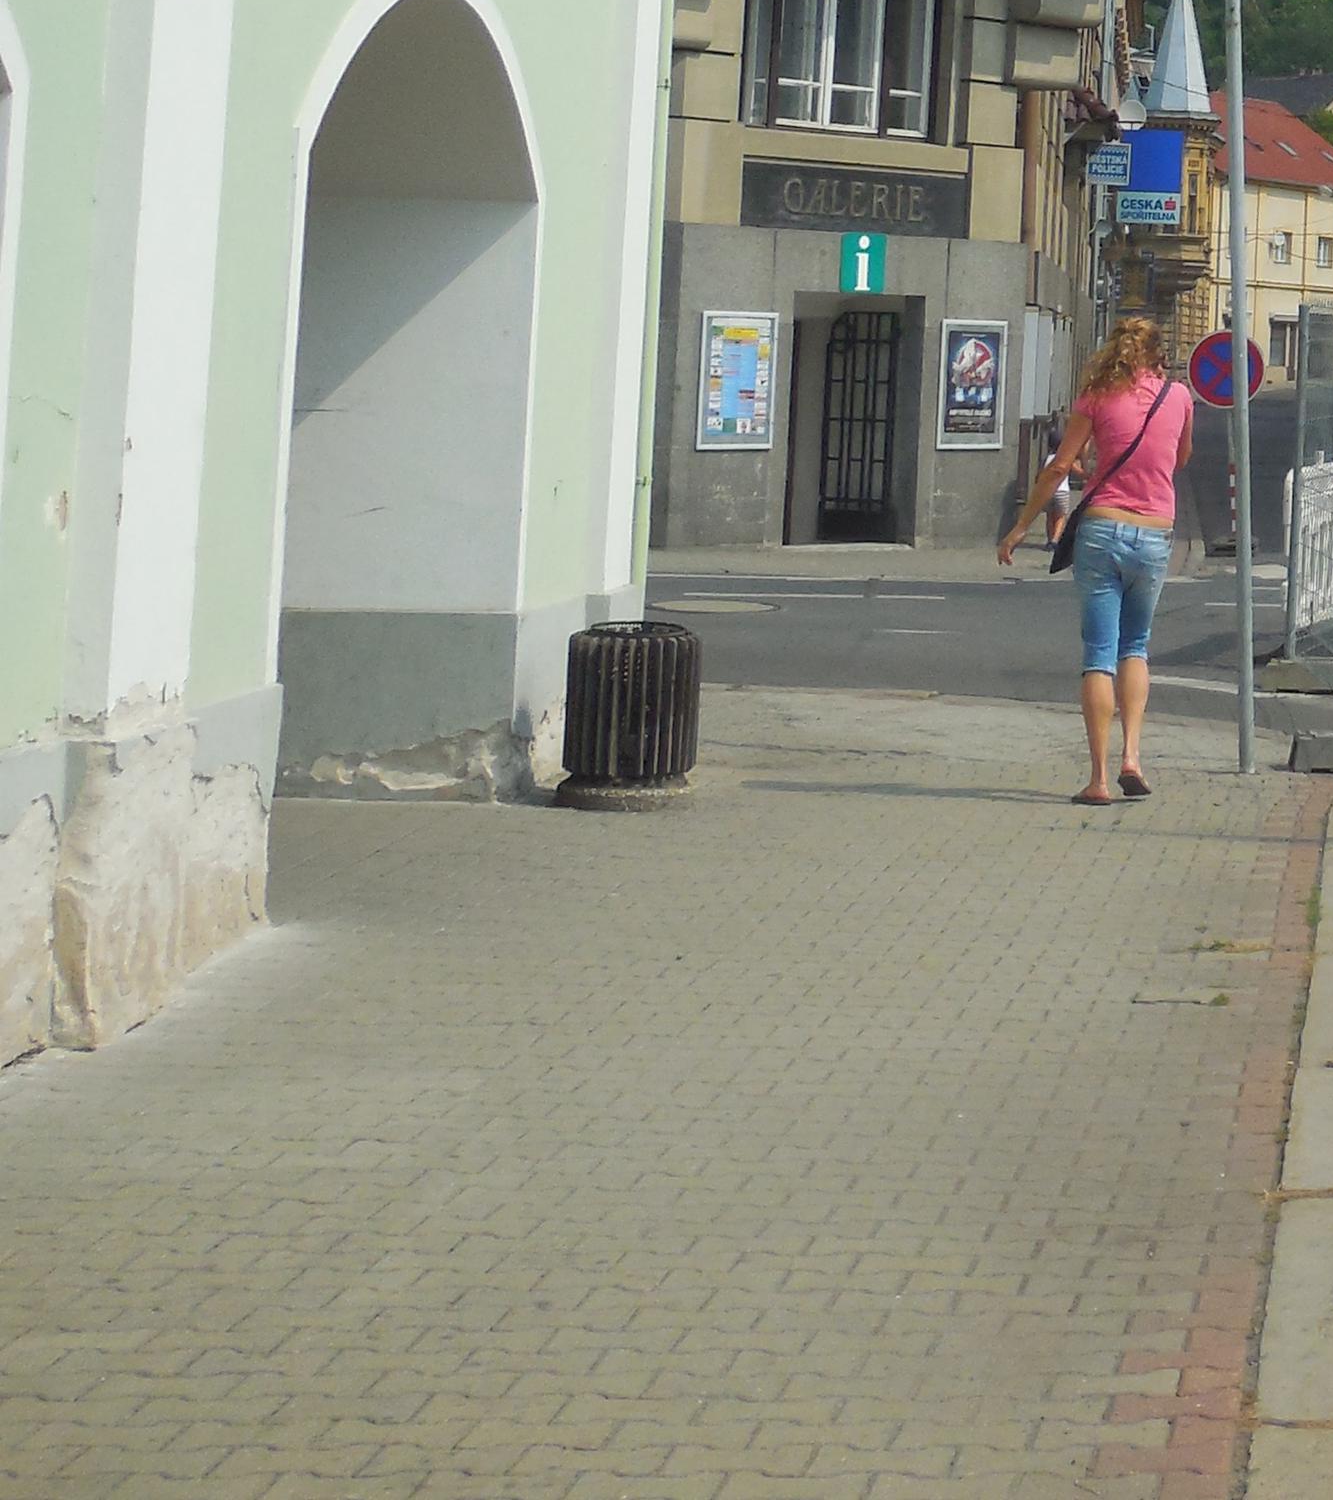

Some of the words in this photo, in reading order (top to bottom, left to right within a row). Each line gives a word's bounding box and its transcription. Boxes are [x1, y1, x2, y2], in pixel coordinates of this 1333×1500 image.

[1092, 164, 1125, 174] POLICIE
[783, 178, 925, 222] GALERIE
[1121, 197, 1163, 211] ČESKÁ
[1121, 211, 1176, 221] SPOŘITELNA
